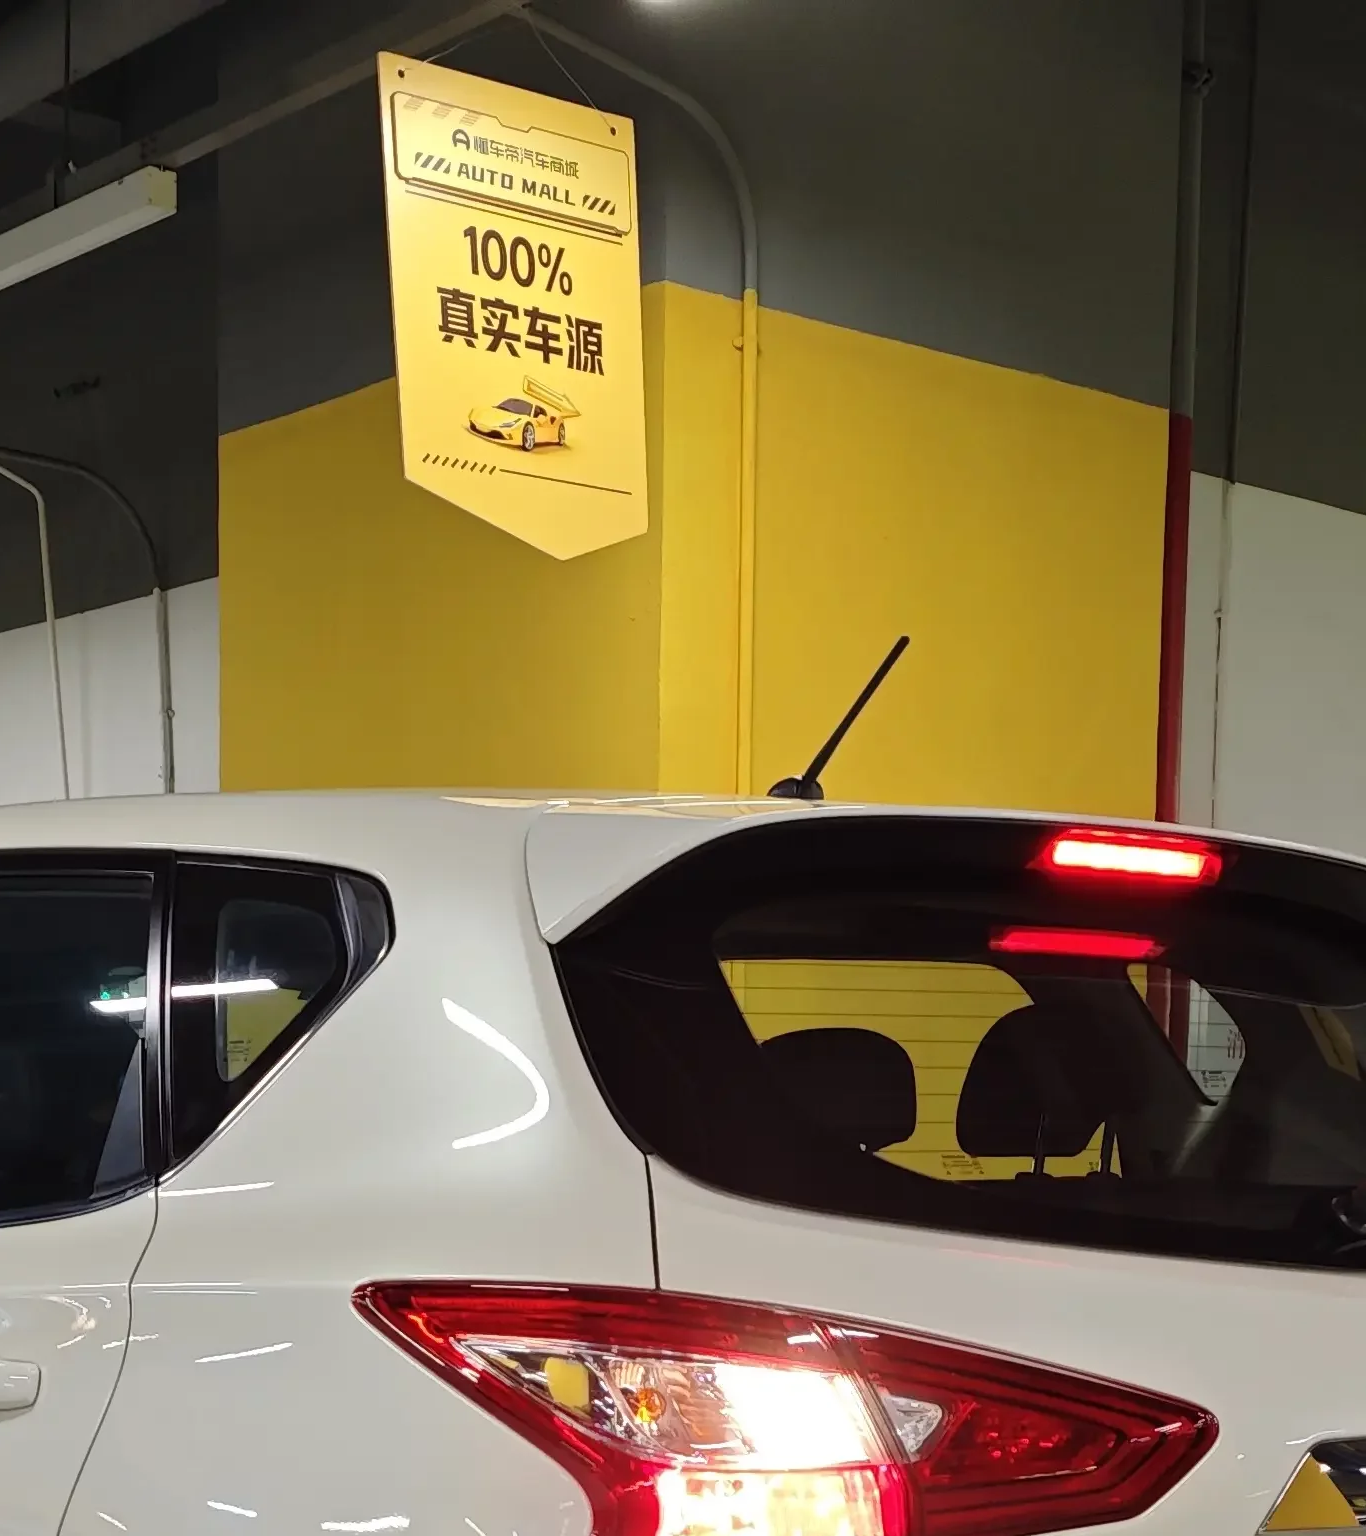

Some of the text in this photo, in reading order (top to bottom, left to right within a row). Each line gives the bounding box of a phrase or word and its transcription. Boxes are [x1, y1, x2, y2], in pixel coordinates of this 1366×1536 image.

[457, 162, 576, 206] AUTO MALL
[473, 135, 580, 180] 懂车帝汽车商城
[463, 225, 573, 297] 100%
[436, 286, 605, 377] 真实车源
